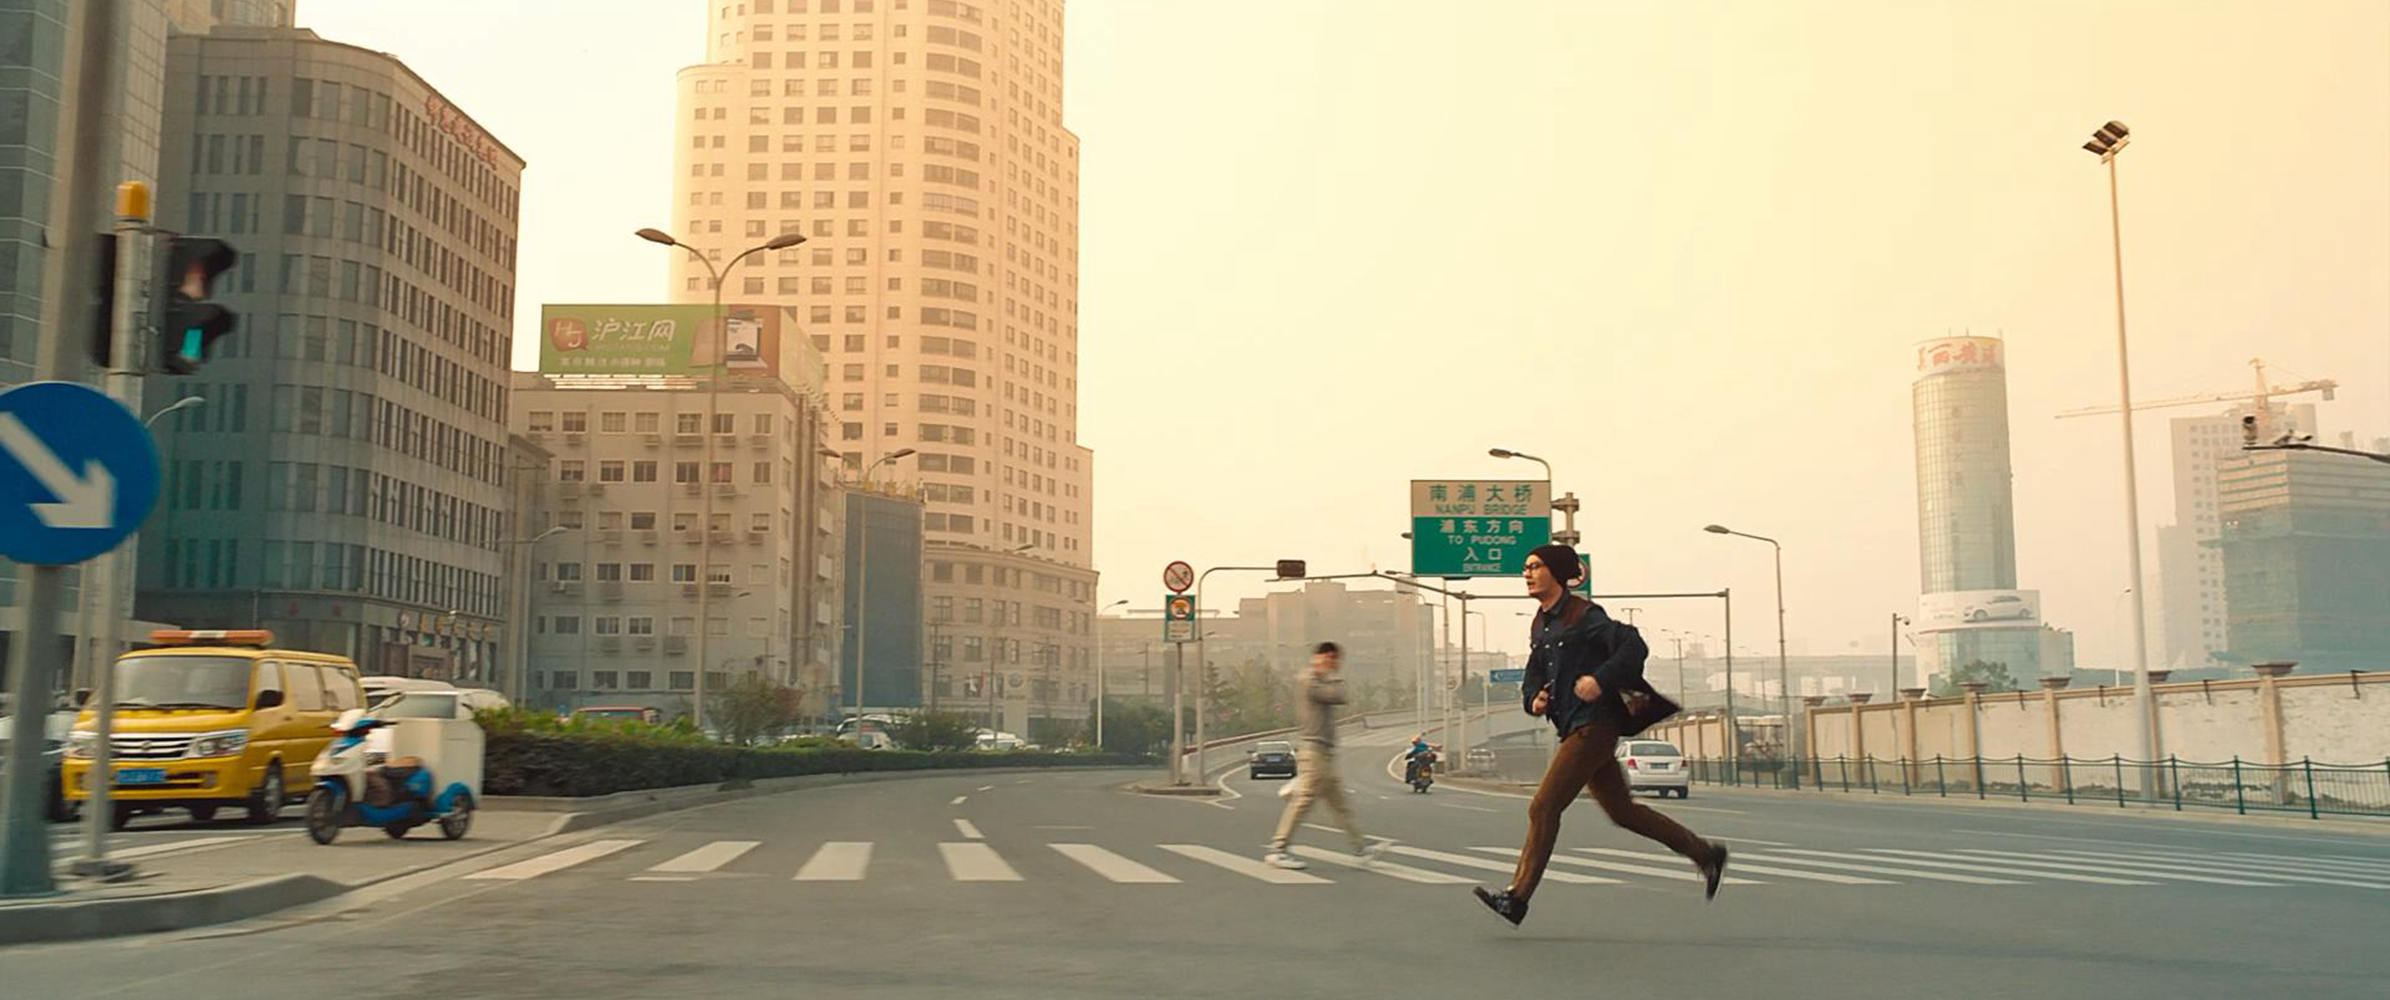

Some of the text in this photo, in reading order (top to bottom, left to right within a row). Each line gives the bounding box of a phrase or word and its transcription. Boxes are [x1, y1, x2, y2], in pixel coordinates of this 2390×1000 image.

[592, 318, 676, 341] 沪江网
[1429, 484, 1533, 502] 南浦大桥
[1435, 504, 1528, 515] NANPU BRIDGE
[1439, 519, 1524, 534] 浦东方向
[1448, 535, 1517, 545] TO PUDONG
[1463, 547, 1502, 561] 入口
